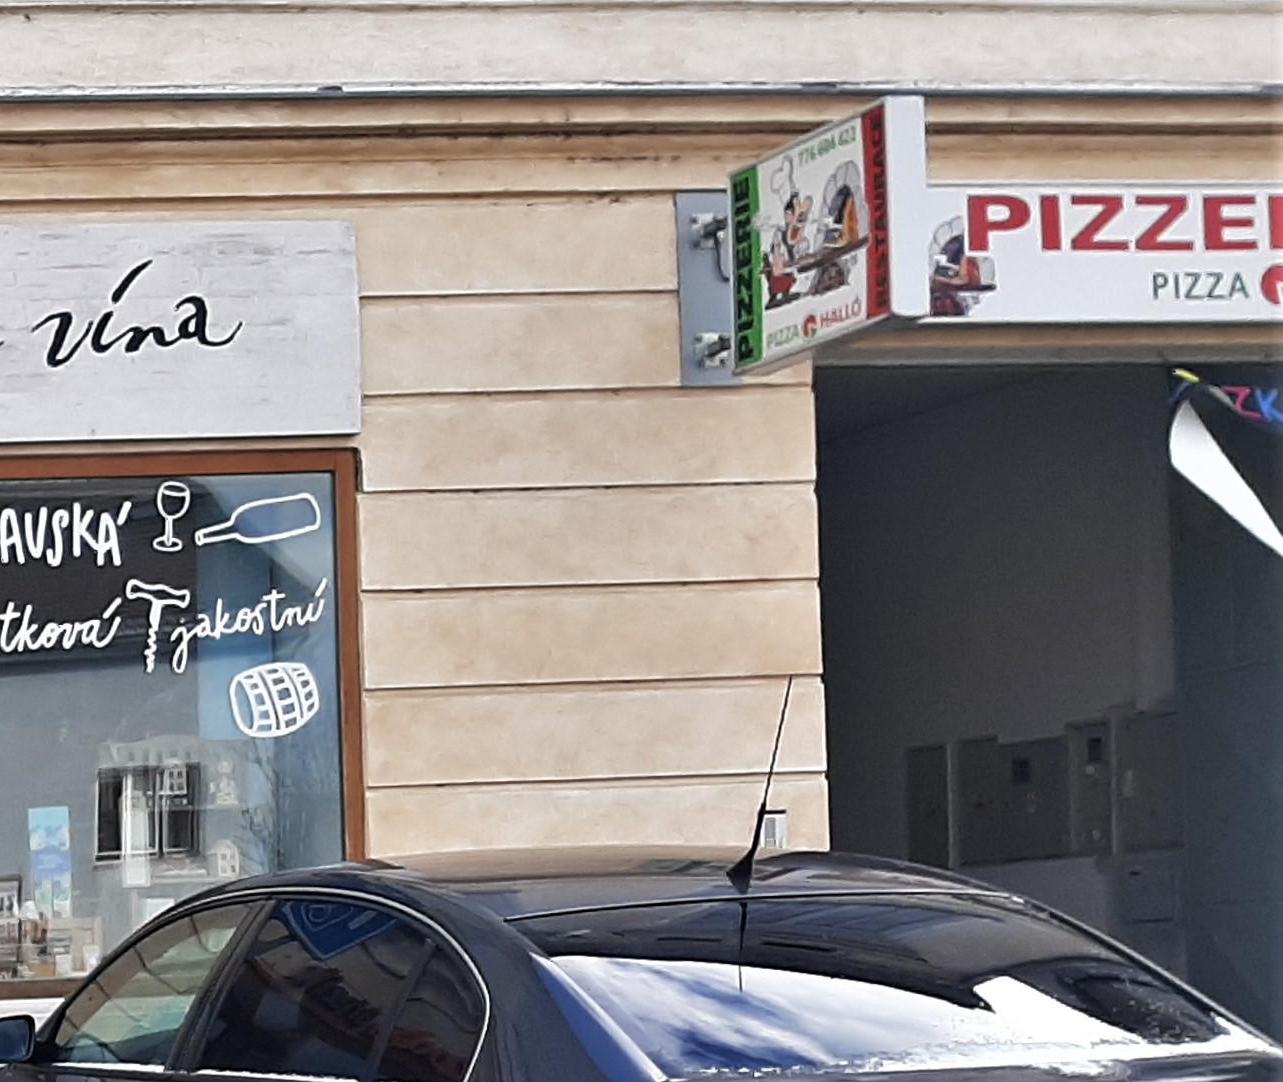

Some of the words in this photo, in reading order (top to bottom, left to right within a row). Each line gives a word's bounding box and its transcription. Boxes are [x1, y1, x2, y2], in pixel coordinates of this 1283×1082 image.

[31, 259, 243, 369] vína
[734, 176, 755, 362] PIZZERIE
[1152, 271, 1250, 299] PIZZA
[170, 577, 328, 674] jakostní
